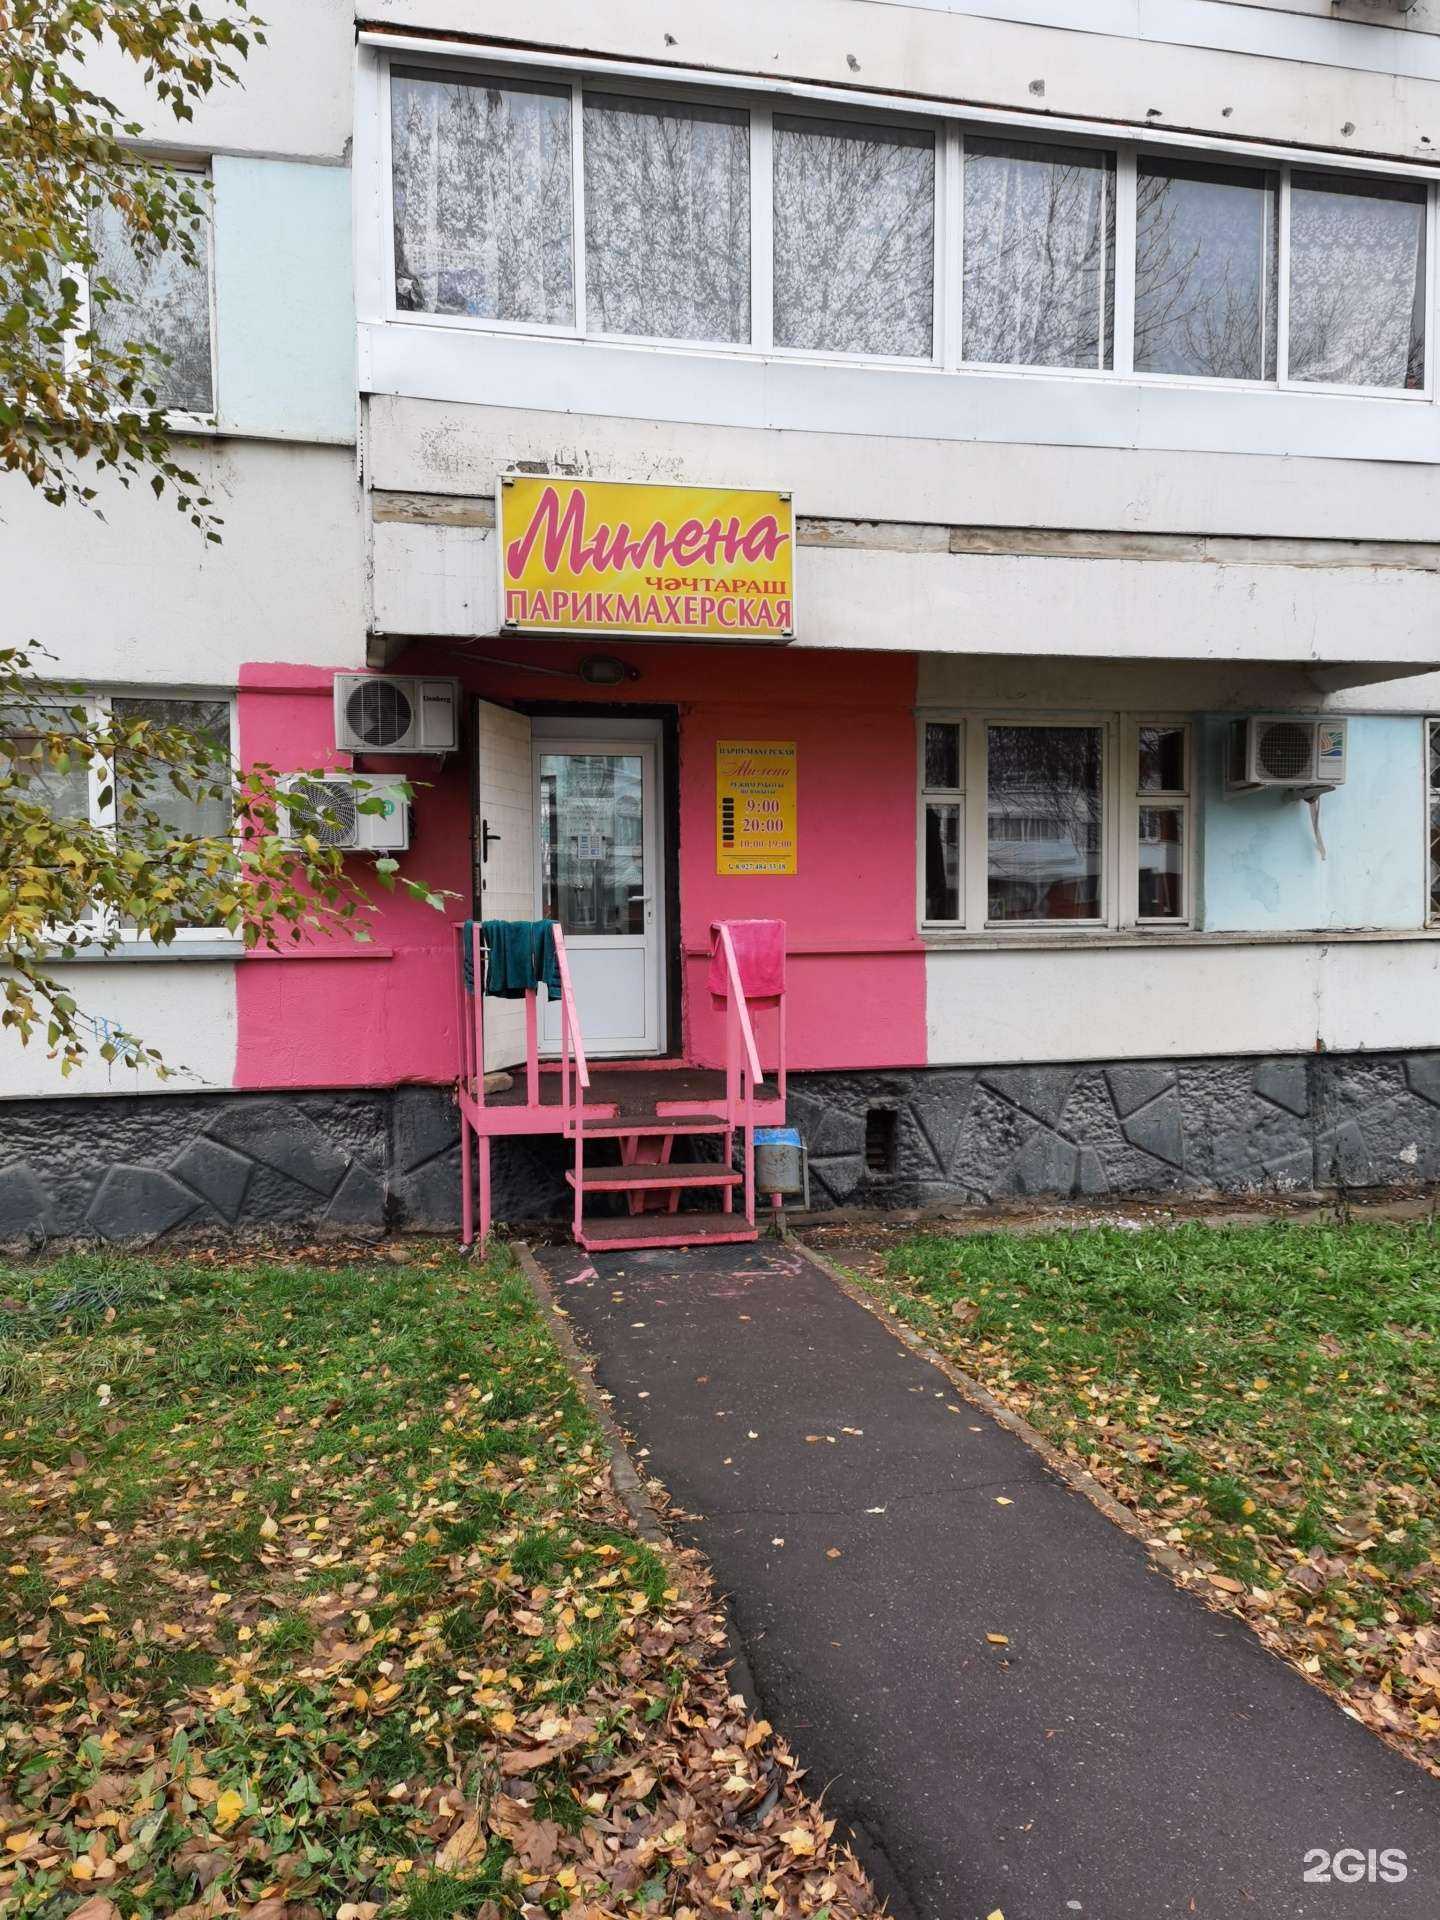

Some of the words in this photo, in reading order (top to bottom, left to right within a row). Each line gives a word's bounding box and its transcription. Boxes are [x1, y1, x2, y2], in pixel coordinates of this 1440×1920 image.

[507, 486, 789, 580] Милена
[645, 576, 787, 595] ЧӘЧТАРАШ
[506, 590, 792, 628] ПАРИКМАХЕРСКАЯ
[747, 799, 779, 813] 9:00
[743, 818, 784, 832] 20:00
